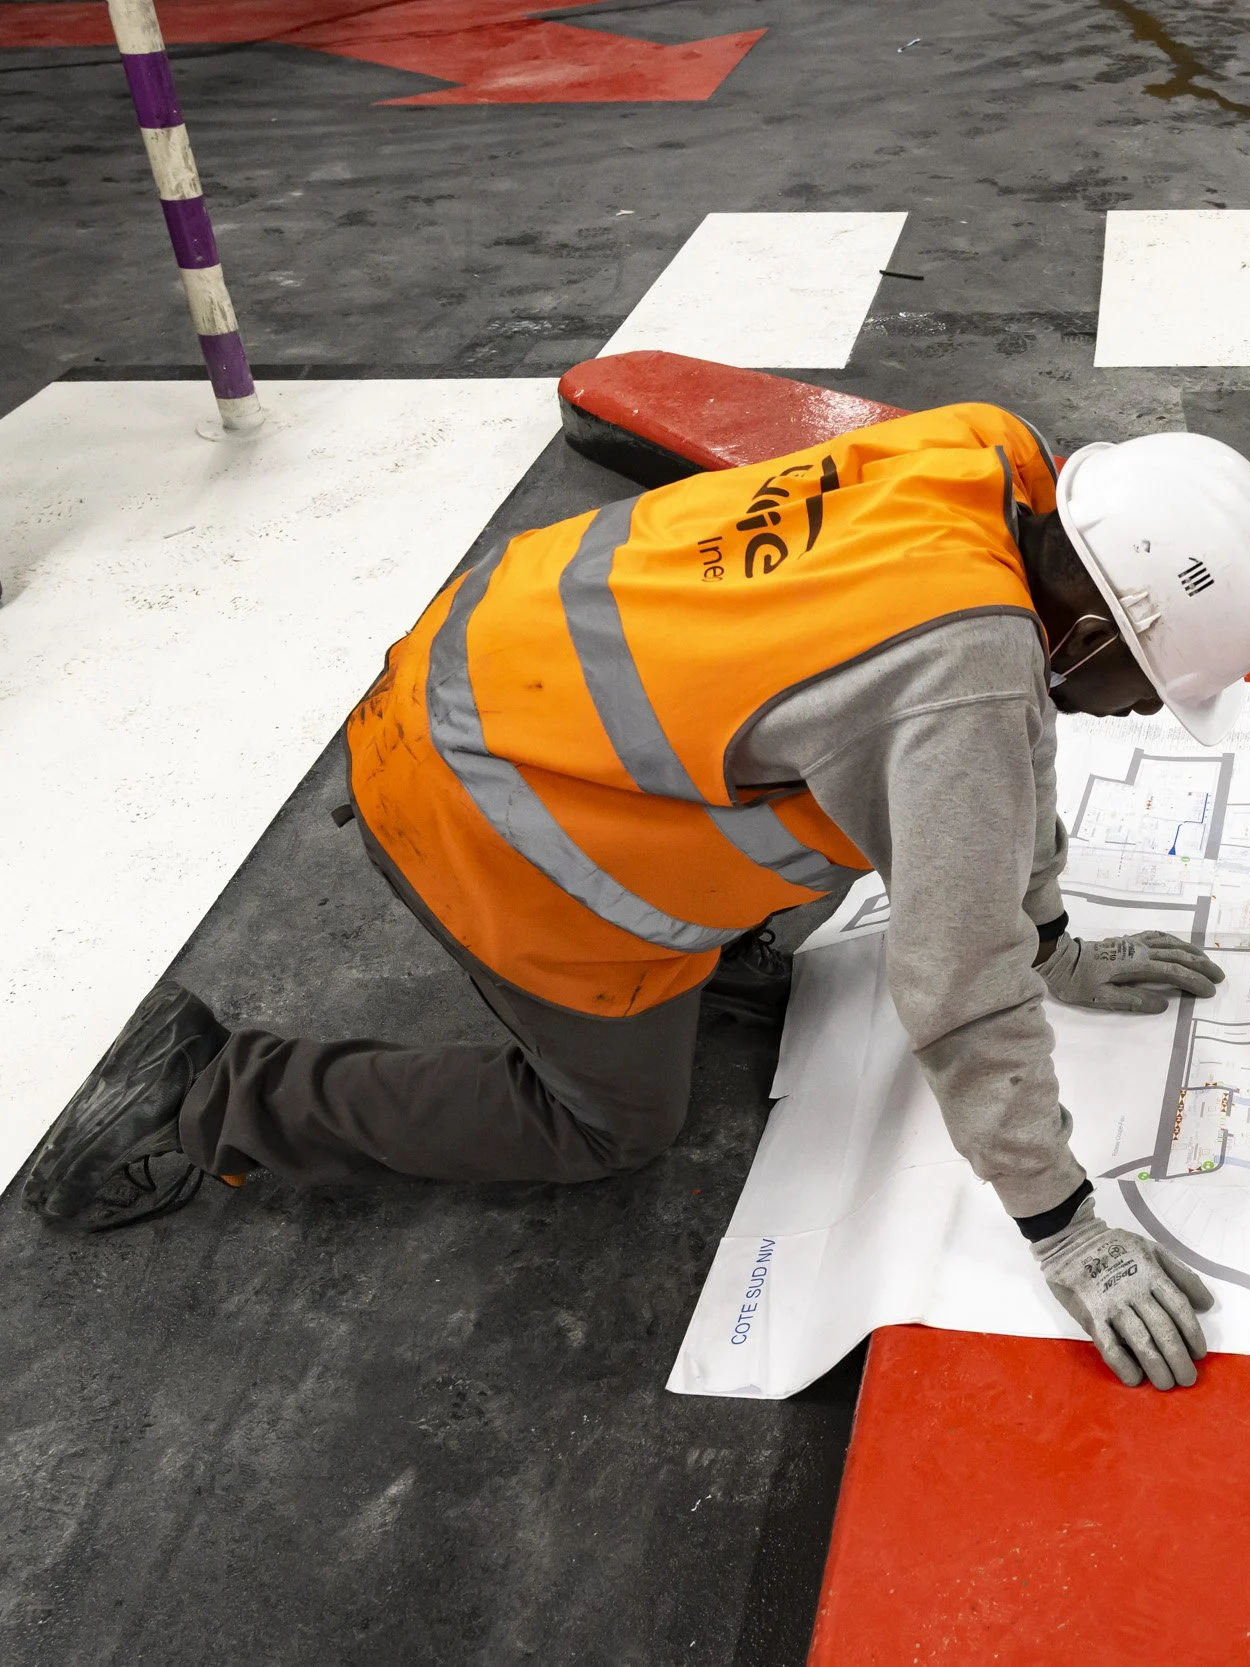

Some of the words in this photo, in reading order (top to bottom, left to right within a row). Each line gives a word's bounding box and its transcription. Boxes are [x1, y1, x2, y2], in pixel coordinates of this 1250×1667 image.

[731, 1302, 758, 1345] COTE
[746, 1265, 768, 1298] SUD
[757, 1238, 776, 1263] NIV
